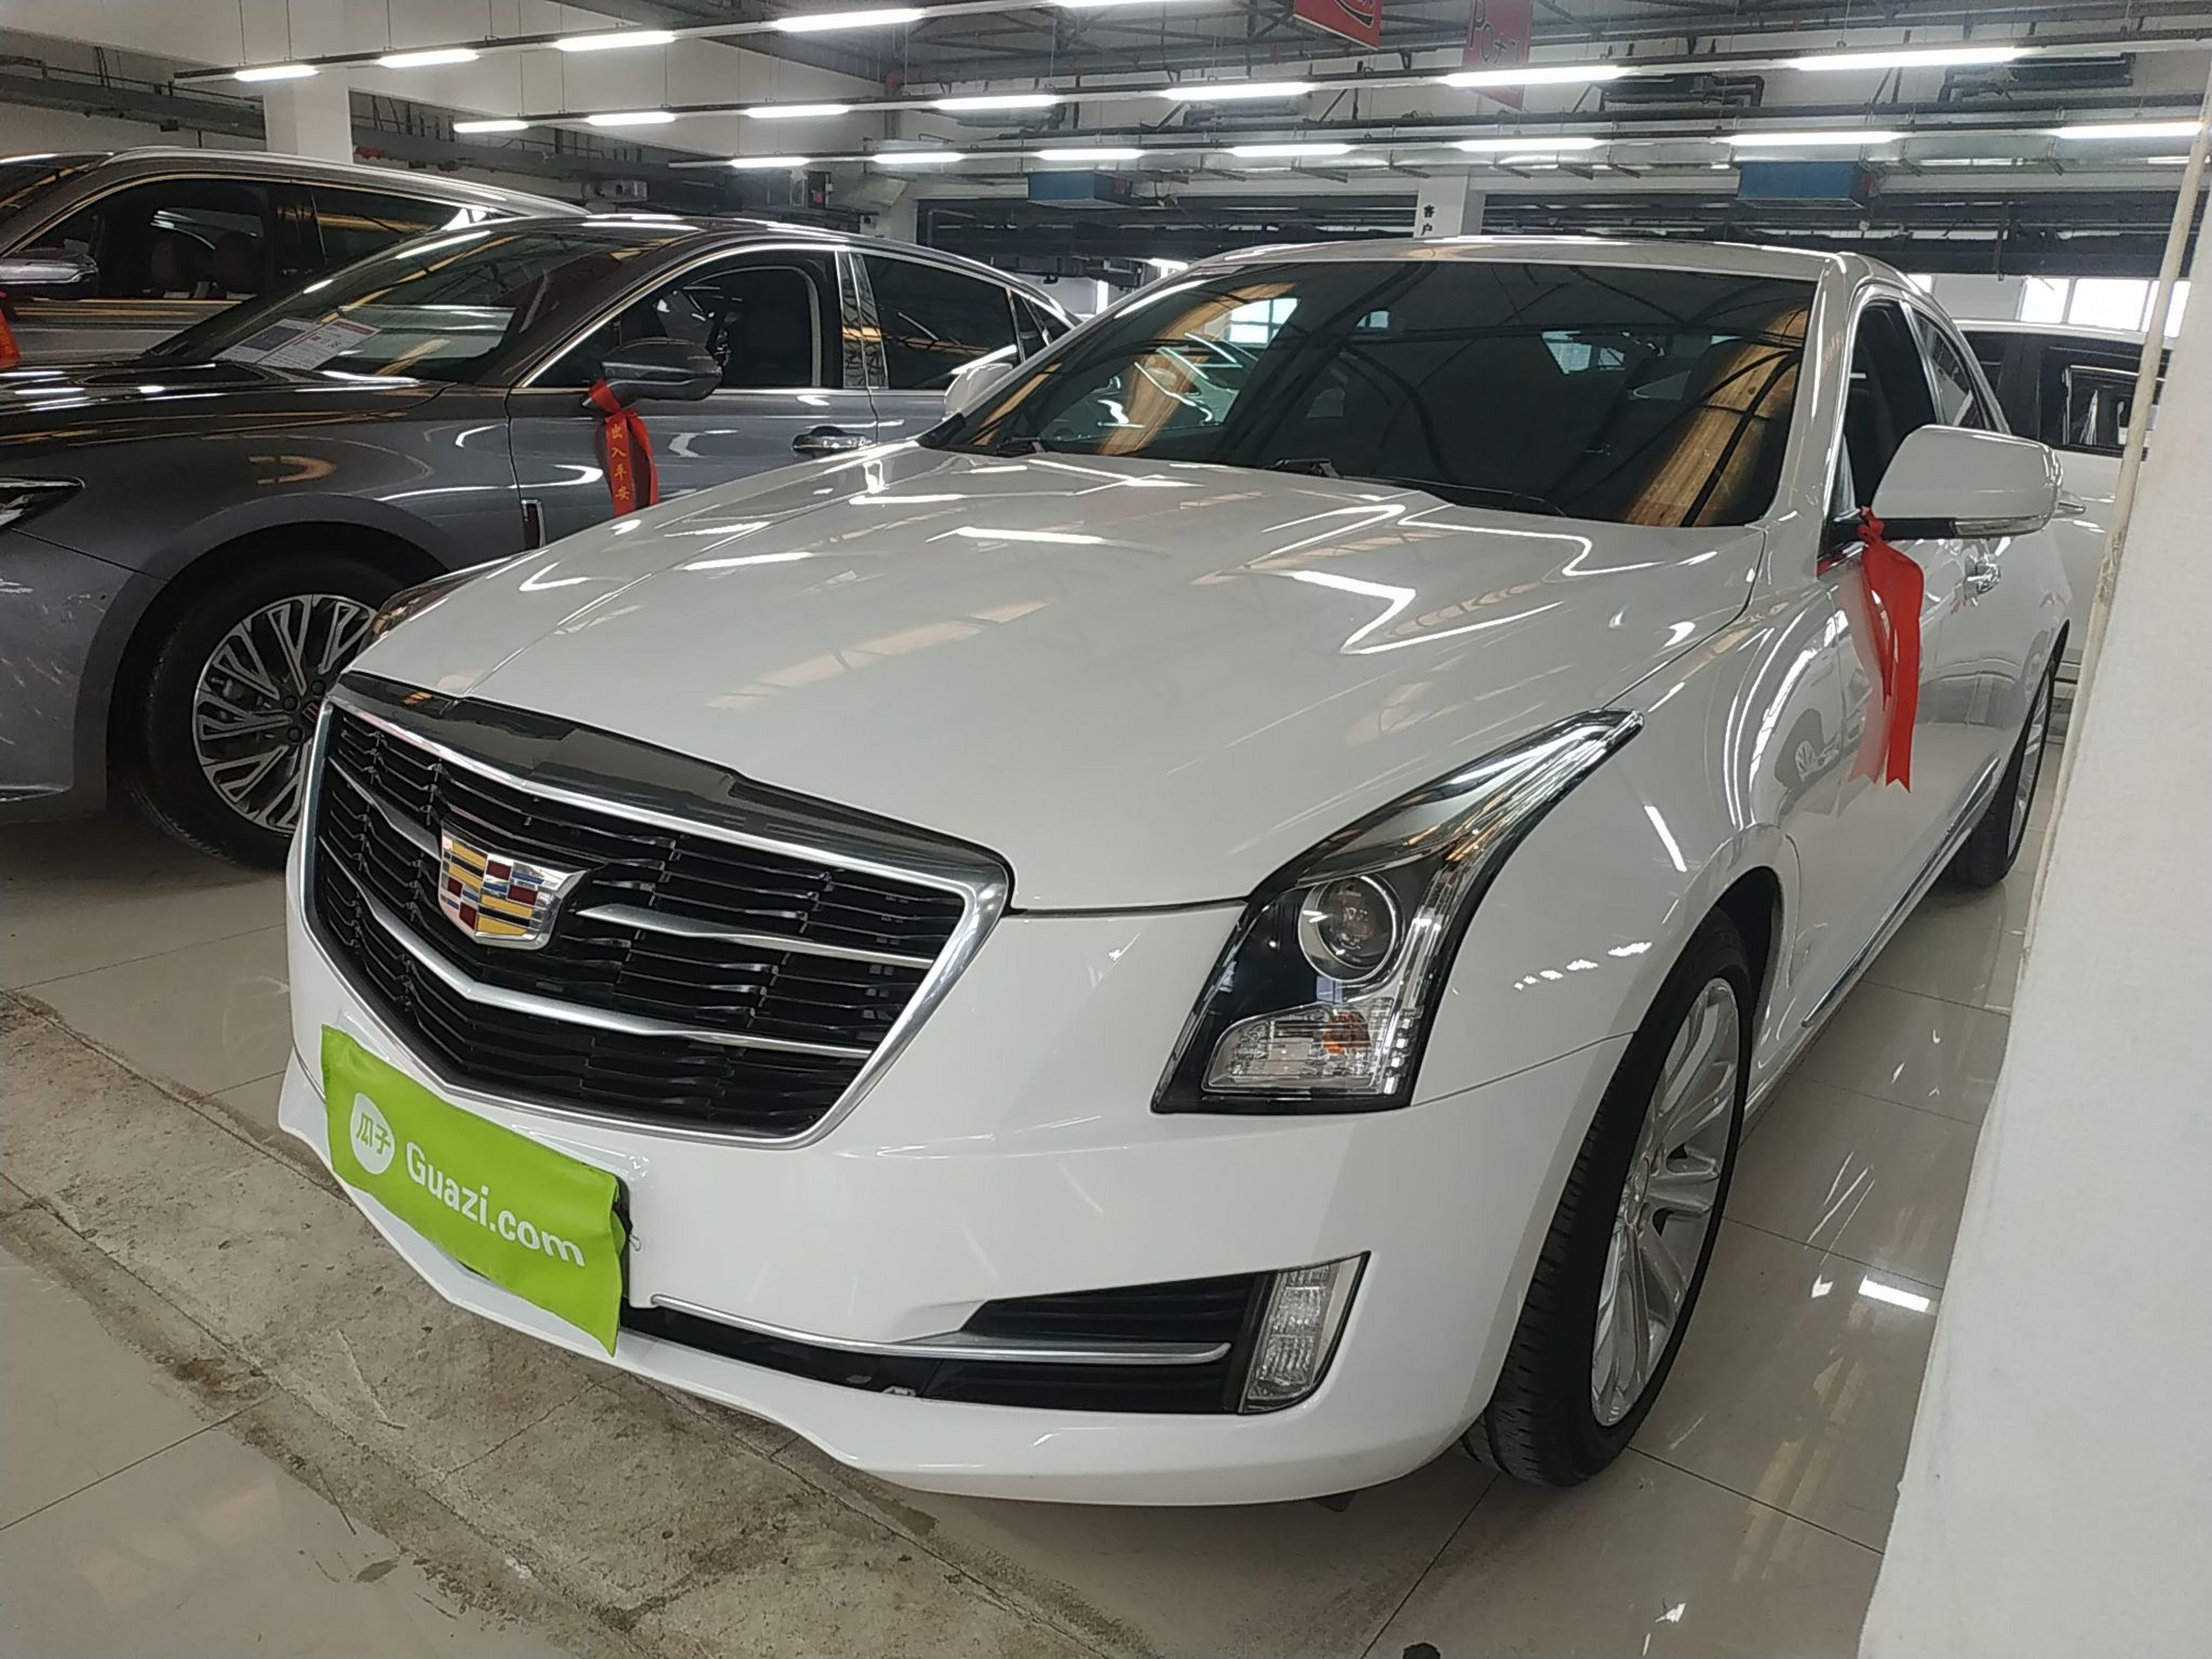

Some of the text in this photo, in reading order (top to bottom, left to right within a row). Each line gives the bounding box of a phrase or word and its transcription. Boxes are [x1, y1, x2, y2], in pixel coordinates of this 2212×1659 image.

[612, 423, 630, 501] 出入平安
[356, 1112, 391, 1155] 瓜子
[406, 1142, 585, 1267] Guazi.com
